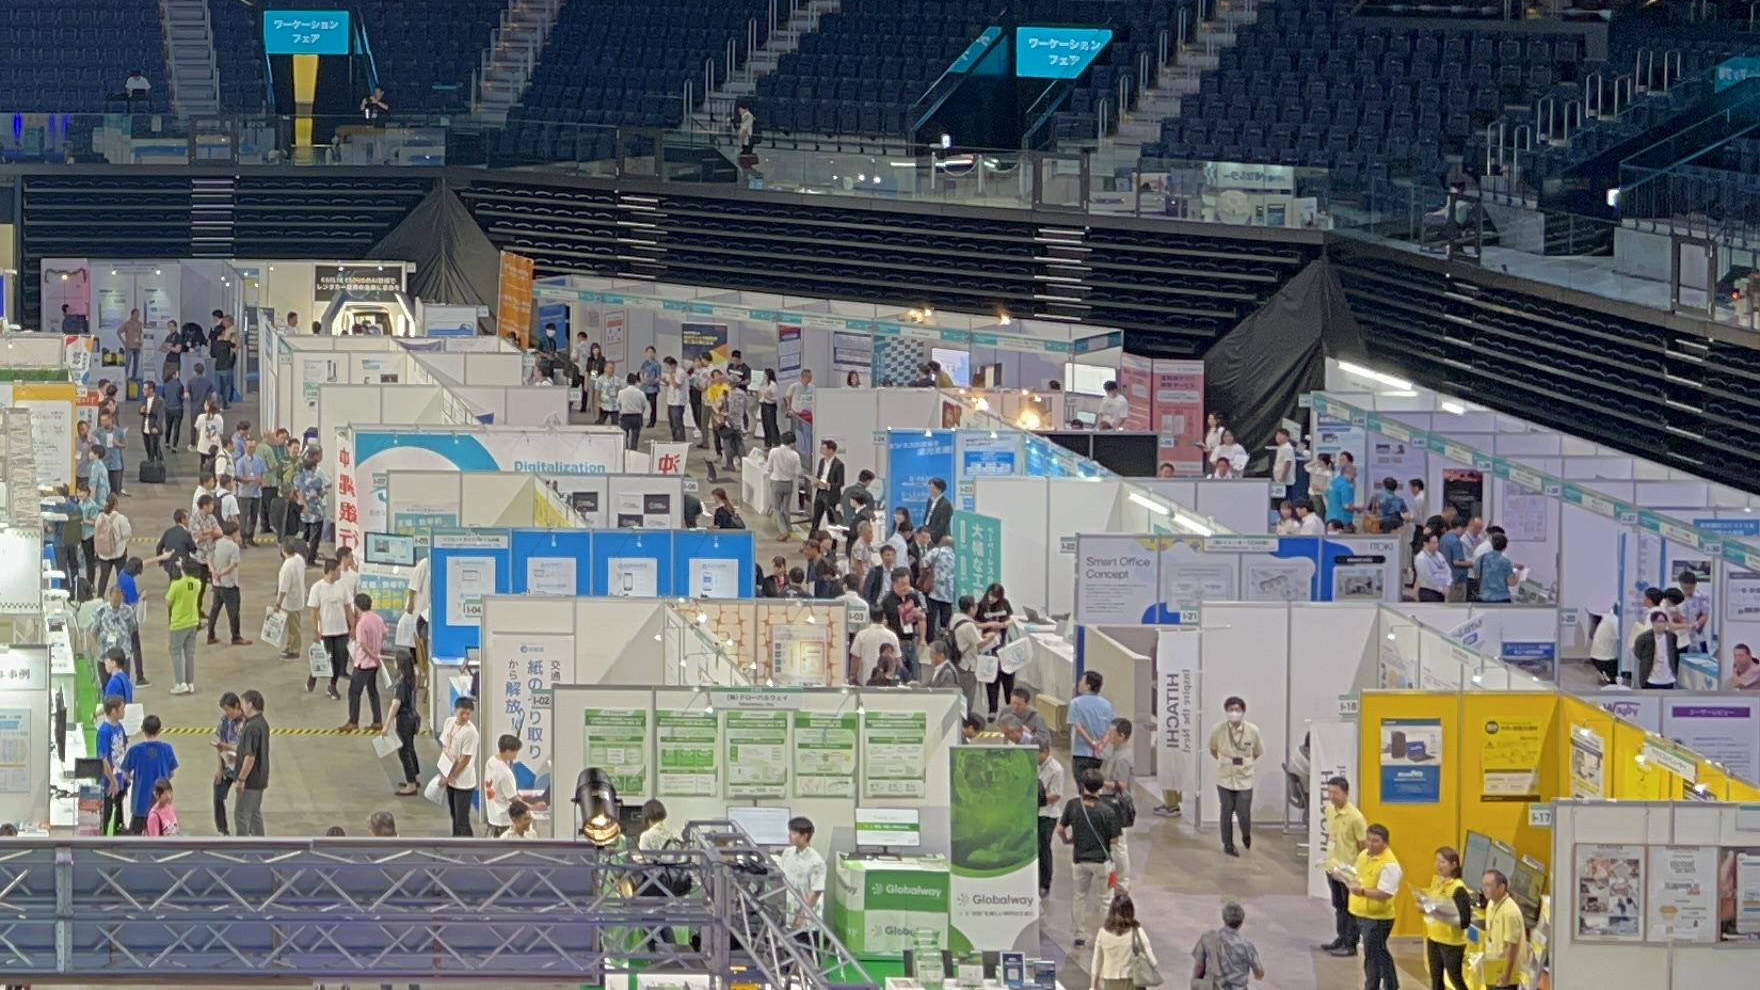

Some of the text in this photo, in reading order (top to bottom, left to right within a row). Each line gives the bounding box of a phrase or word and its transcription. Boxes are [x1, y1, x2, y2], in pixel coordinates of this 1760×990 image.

[273, 19, 339, 30] ワーケーション
[292, 33, 320, 44] フェア
[1028, 37, 1101, 51] ワーケーション
[1048, 54, 1080, 66] フェア
[514, 460, 606, 474] Digitalization
[1085, 556, 1151, 568] Smart Office
[1085, 569, 1129, 580] Concept
[527, 660, 544, 759] 紙のり取り
[885, 884, 943, 898] Globalway
[972, 893, 1034, 908] Globalway
